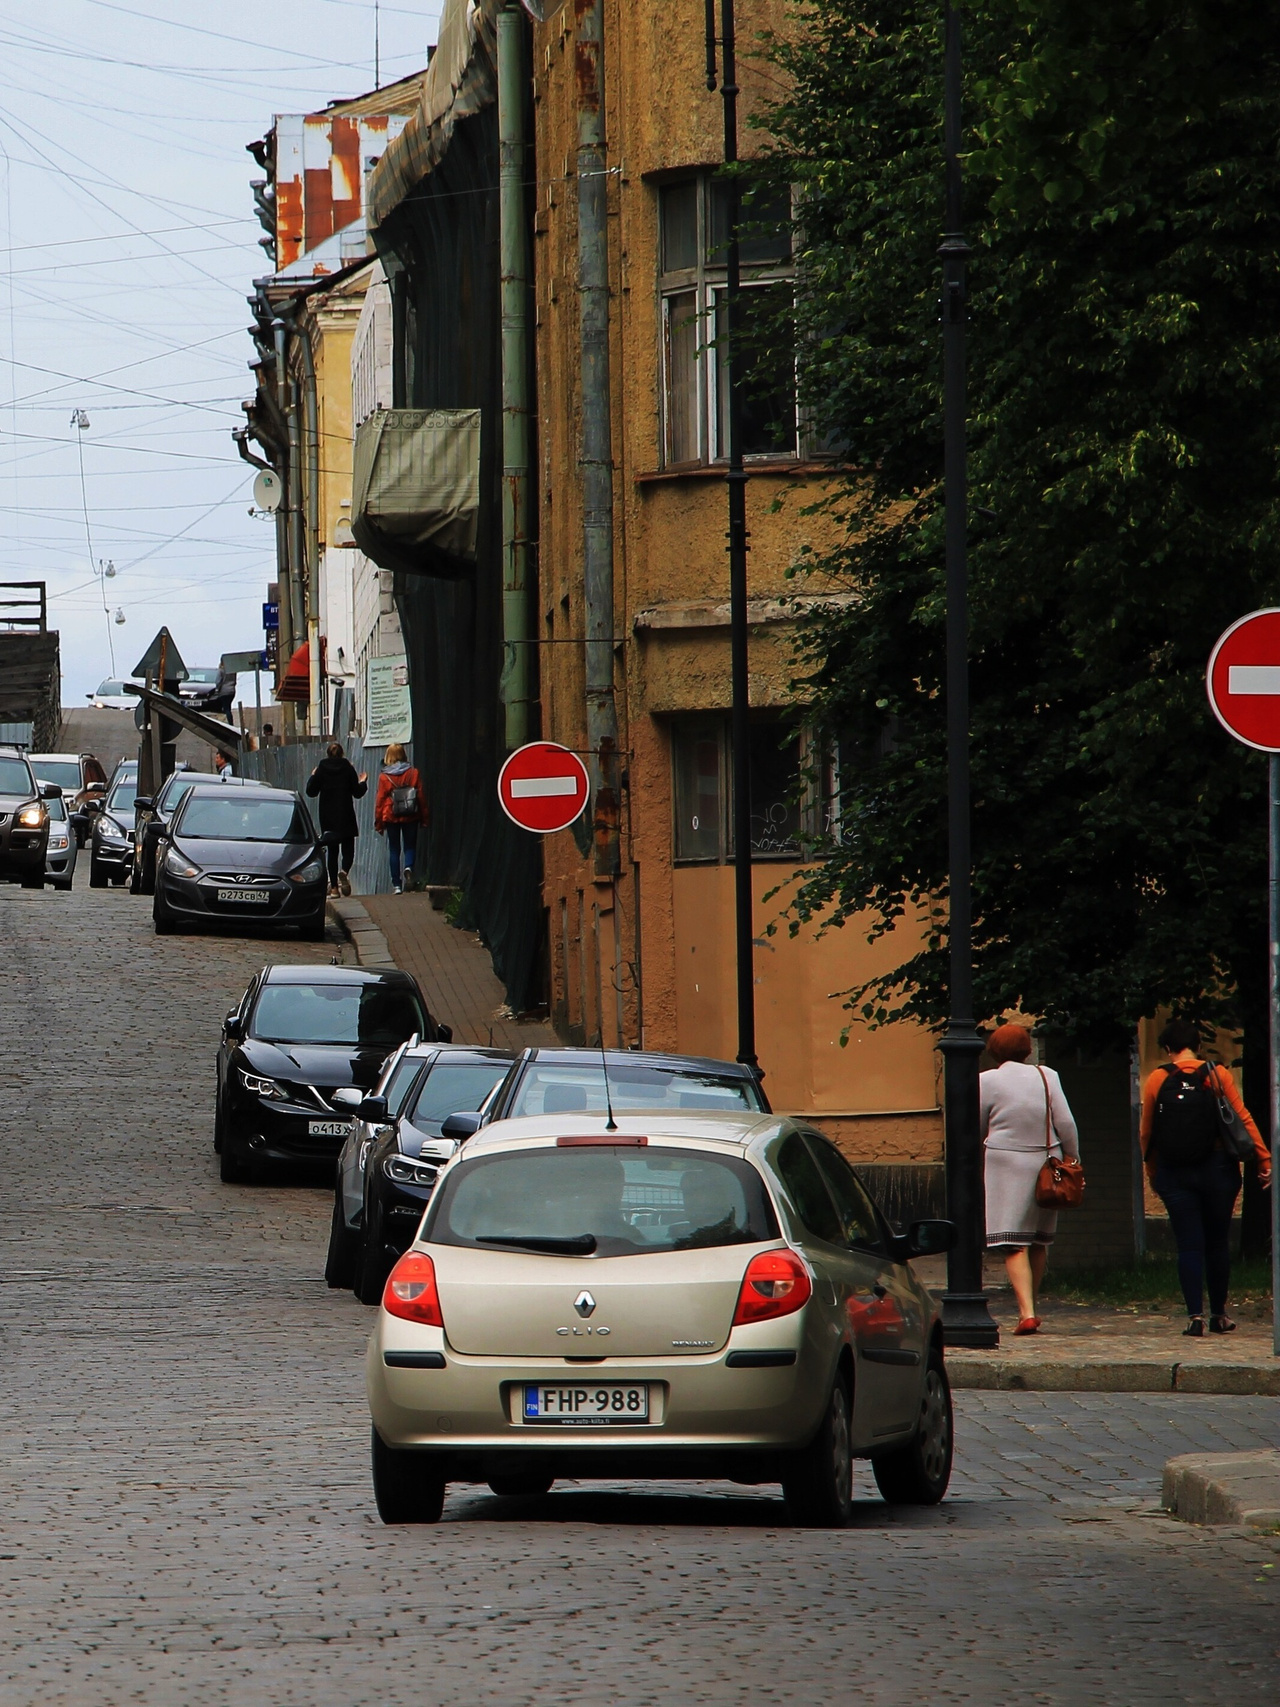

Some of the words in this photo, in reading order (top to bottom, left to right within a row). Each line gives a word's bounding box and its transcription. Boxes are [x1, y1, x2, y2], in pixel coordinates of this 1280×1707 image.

[257, 891, 267, 899] 47
[556, 1326, 611, 1336] CLIO
[671, 1339, 716, 1348] RENAULT
[543, 1389, 641, 1412] FHP-988
[526, 1403, 538, 1411] FIN
